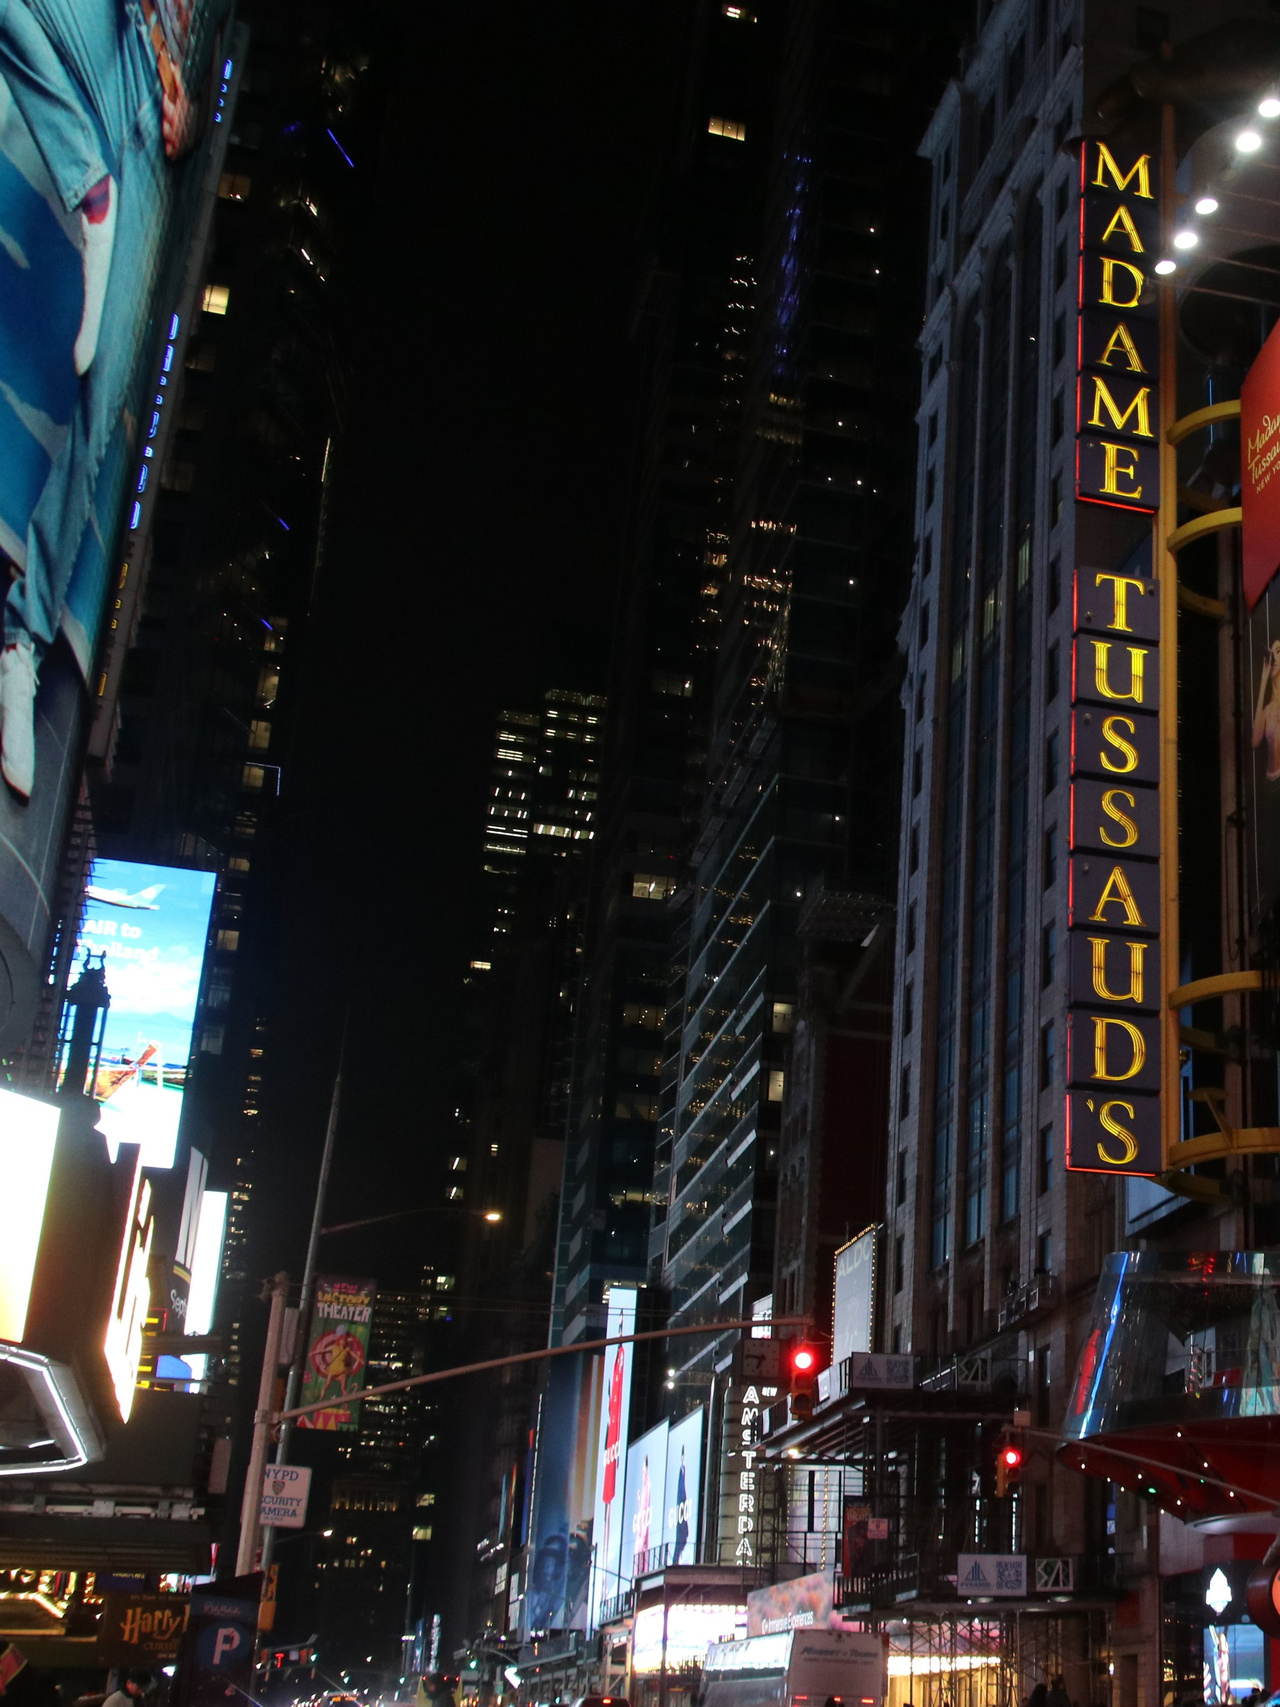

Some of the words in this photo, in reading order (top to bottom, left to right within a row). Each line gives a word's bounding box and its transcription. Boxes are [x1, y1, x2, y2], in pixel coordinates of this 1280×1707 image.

[1087, 141, 1155, 500] MADAME
[1256, 471, 1272, 495] NEW
[1086, 573, 1149, 1166] TUSSAUD'S
[82, 919, 118, 936] AIR
[121, 923, 142, 939] to
[316, 1302, 372, 1323] THEATER
[761, 1386, 778, 1397] NEW
[265, 1468, 299, 1481] NYPD
[736, 1385, 760, 1567] AMSTERDA
[260, 1506, 297, 1518] AMERA
[261, 1495, 302, 1507] CURITY
[669, 1498, 692, 1529] GUCCI
[120, 1606, 182, 1645] Harry
[213, 1627, 241, 1666] P
